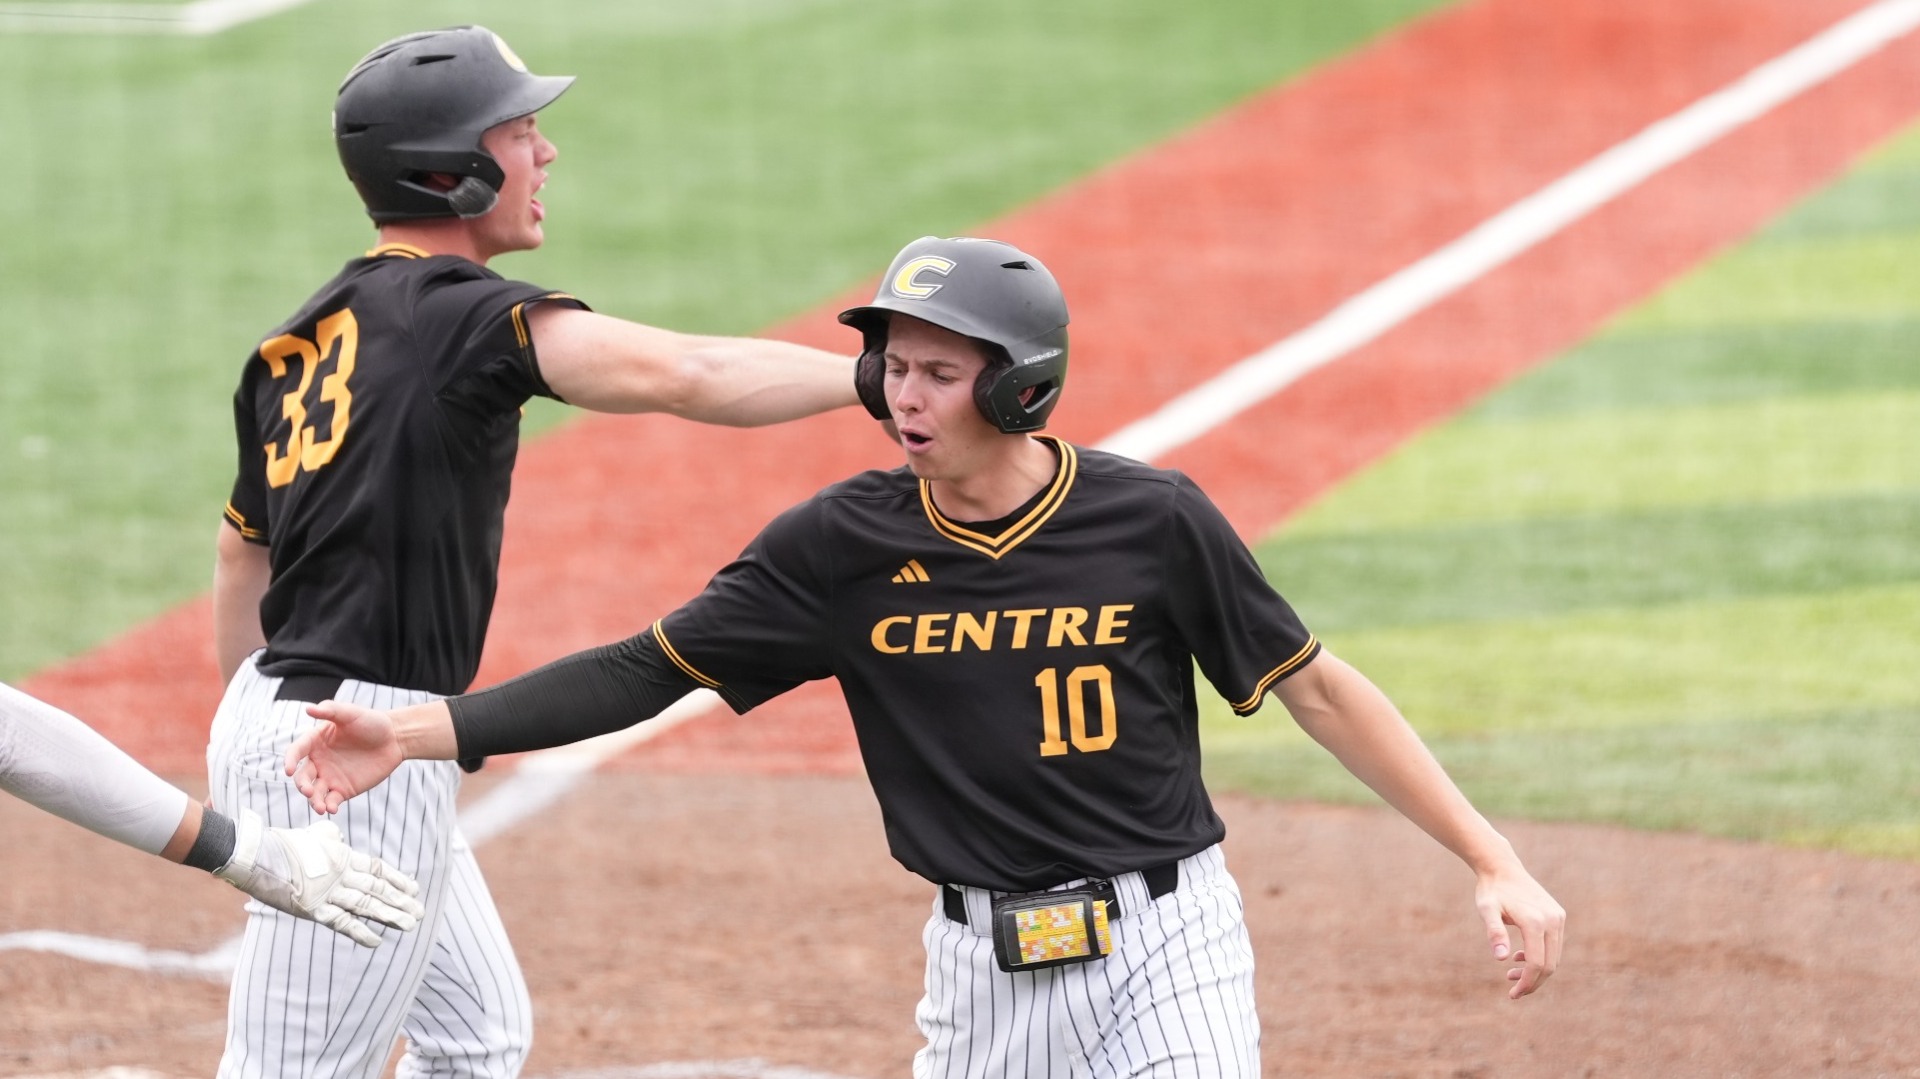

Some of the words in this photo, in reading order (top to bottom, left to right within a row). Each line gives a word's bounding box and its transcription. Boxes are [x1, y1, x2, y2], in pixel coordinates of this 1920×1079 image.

[892, 255, 957, 300] C
[260, 307, 358, 488] 33
[871, 604, 1134, 654] CENTRE
[1035, 664, 1117, 756] 10
